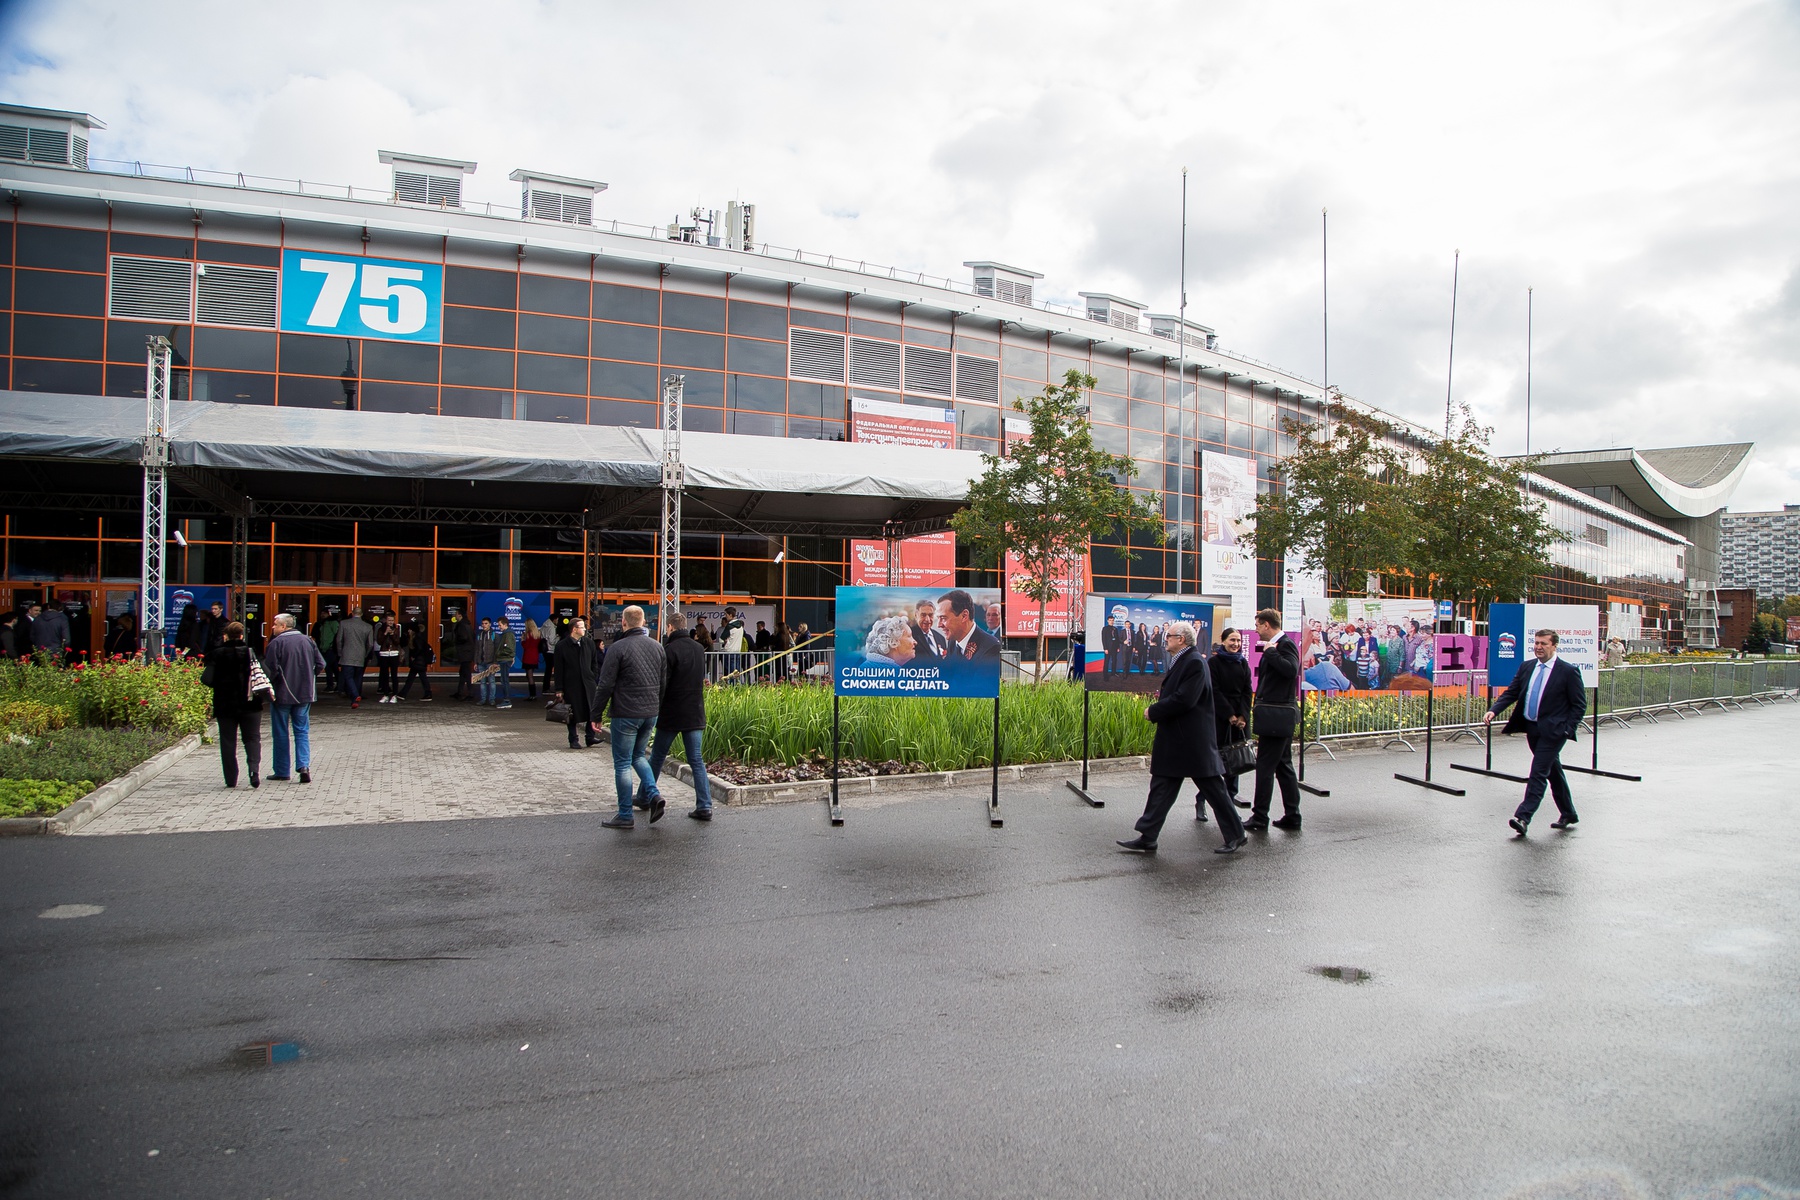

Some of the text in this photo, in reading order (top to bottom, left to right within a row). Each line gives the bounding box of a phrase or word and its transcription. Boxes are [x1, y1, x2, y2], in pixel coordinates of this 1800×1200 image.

[300, 258, 427, 335] 75
[856, 420, 898, 430] ФЕДЕРАЛЬНАЯ
[898, 425, 924, 433] ОПТОВАЯ
[686, 611, 746, 620] ВИКТОРНА
[842, 666, 940, 679] СЛЫШИМ ЛЮДЕЙ
[841, 679, 950, 691] СМОЖЕМ СДЕЛАТЬ
